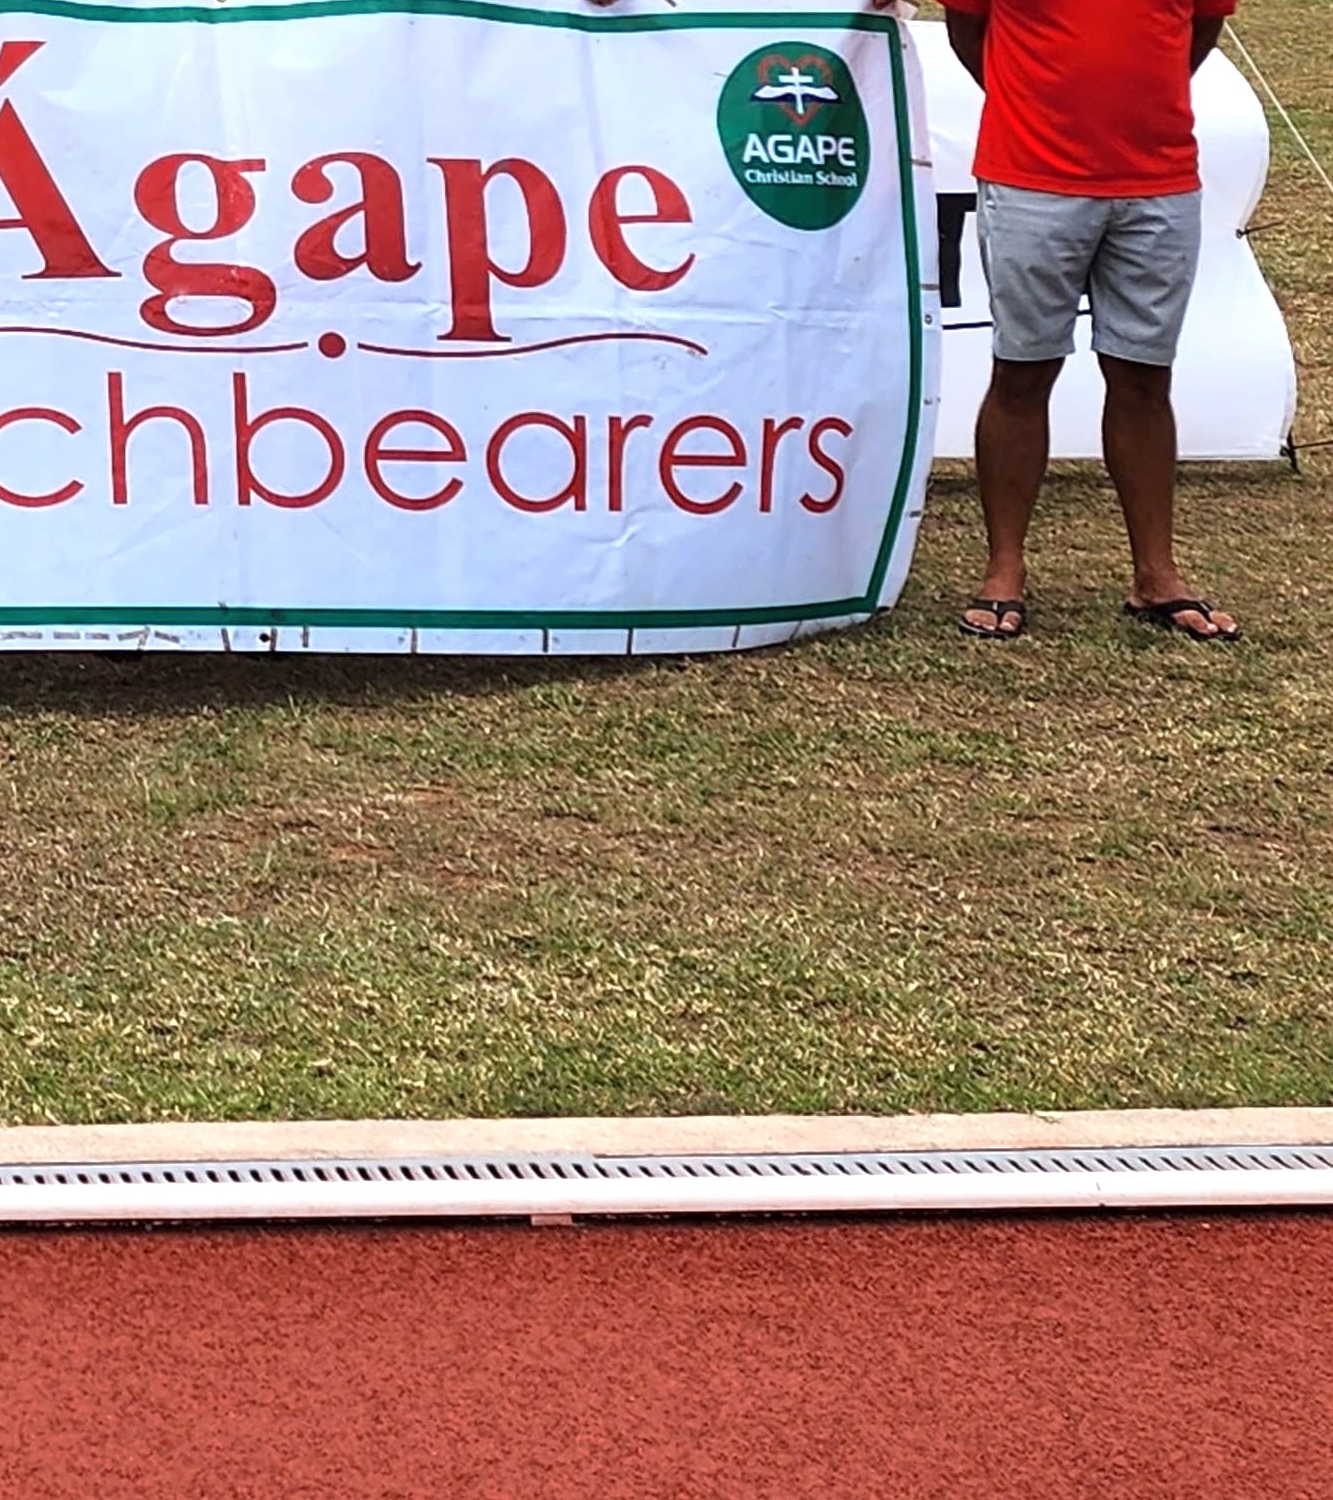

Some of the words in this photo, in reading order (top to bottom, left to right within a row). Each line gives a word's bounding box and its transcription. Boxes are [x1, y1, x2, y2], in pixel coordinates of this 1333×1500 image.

[742, 132, 856, 167] AGAPE
[744, 168, 813, 185] Christian
[815, 171, 858, 188] School
